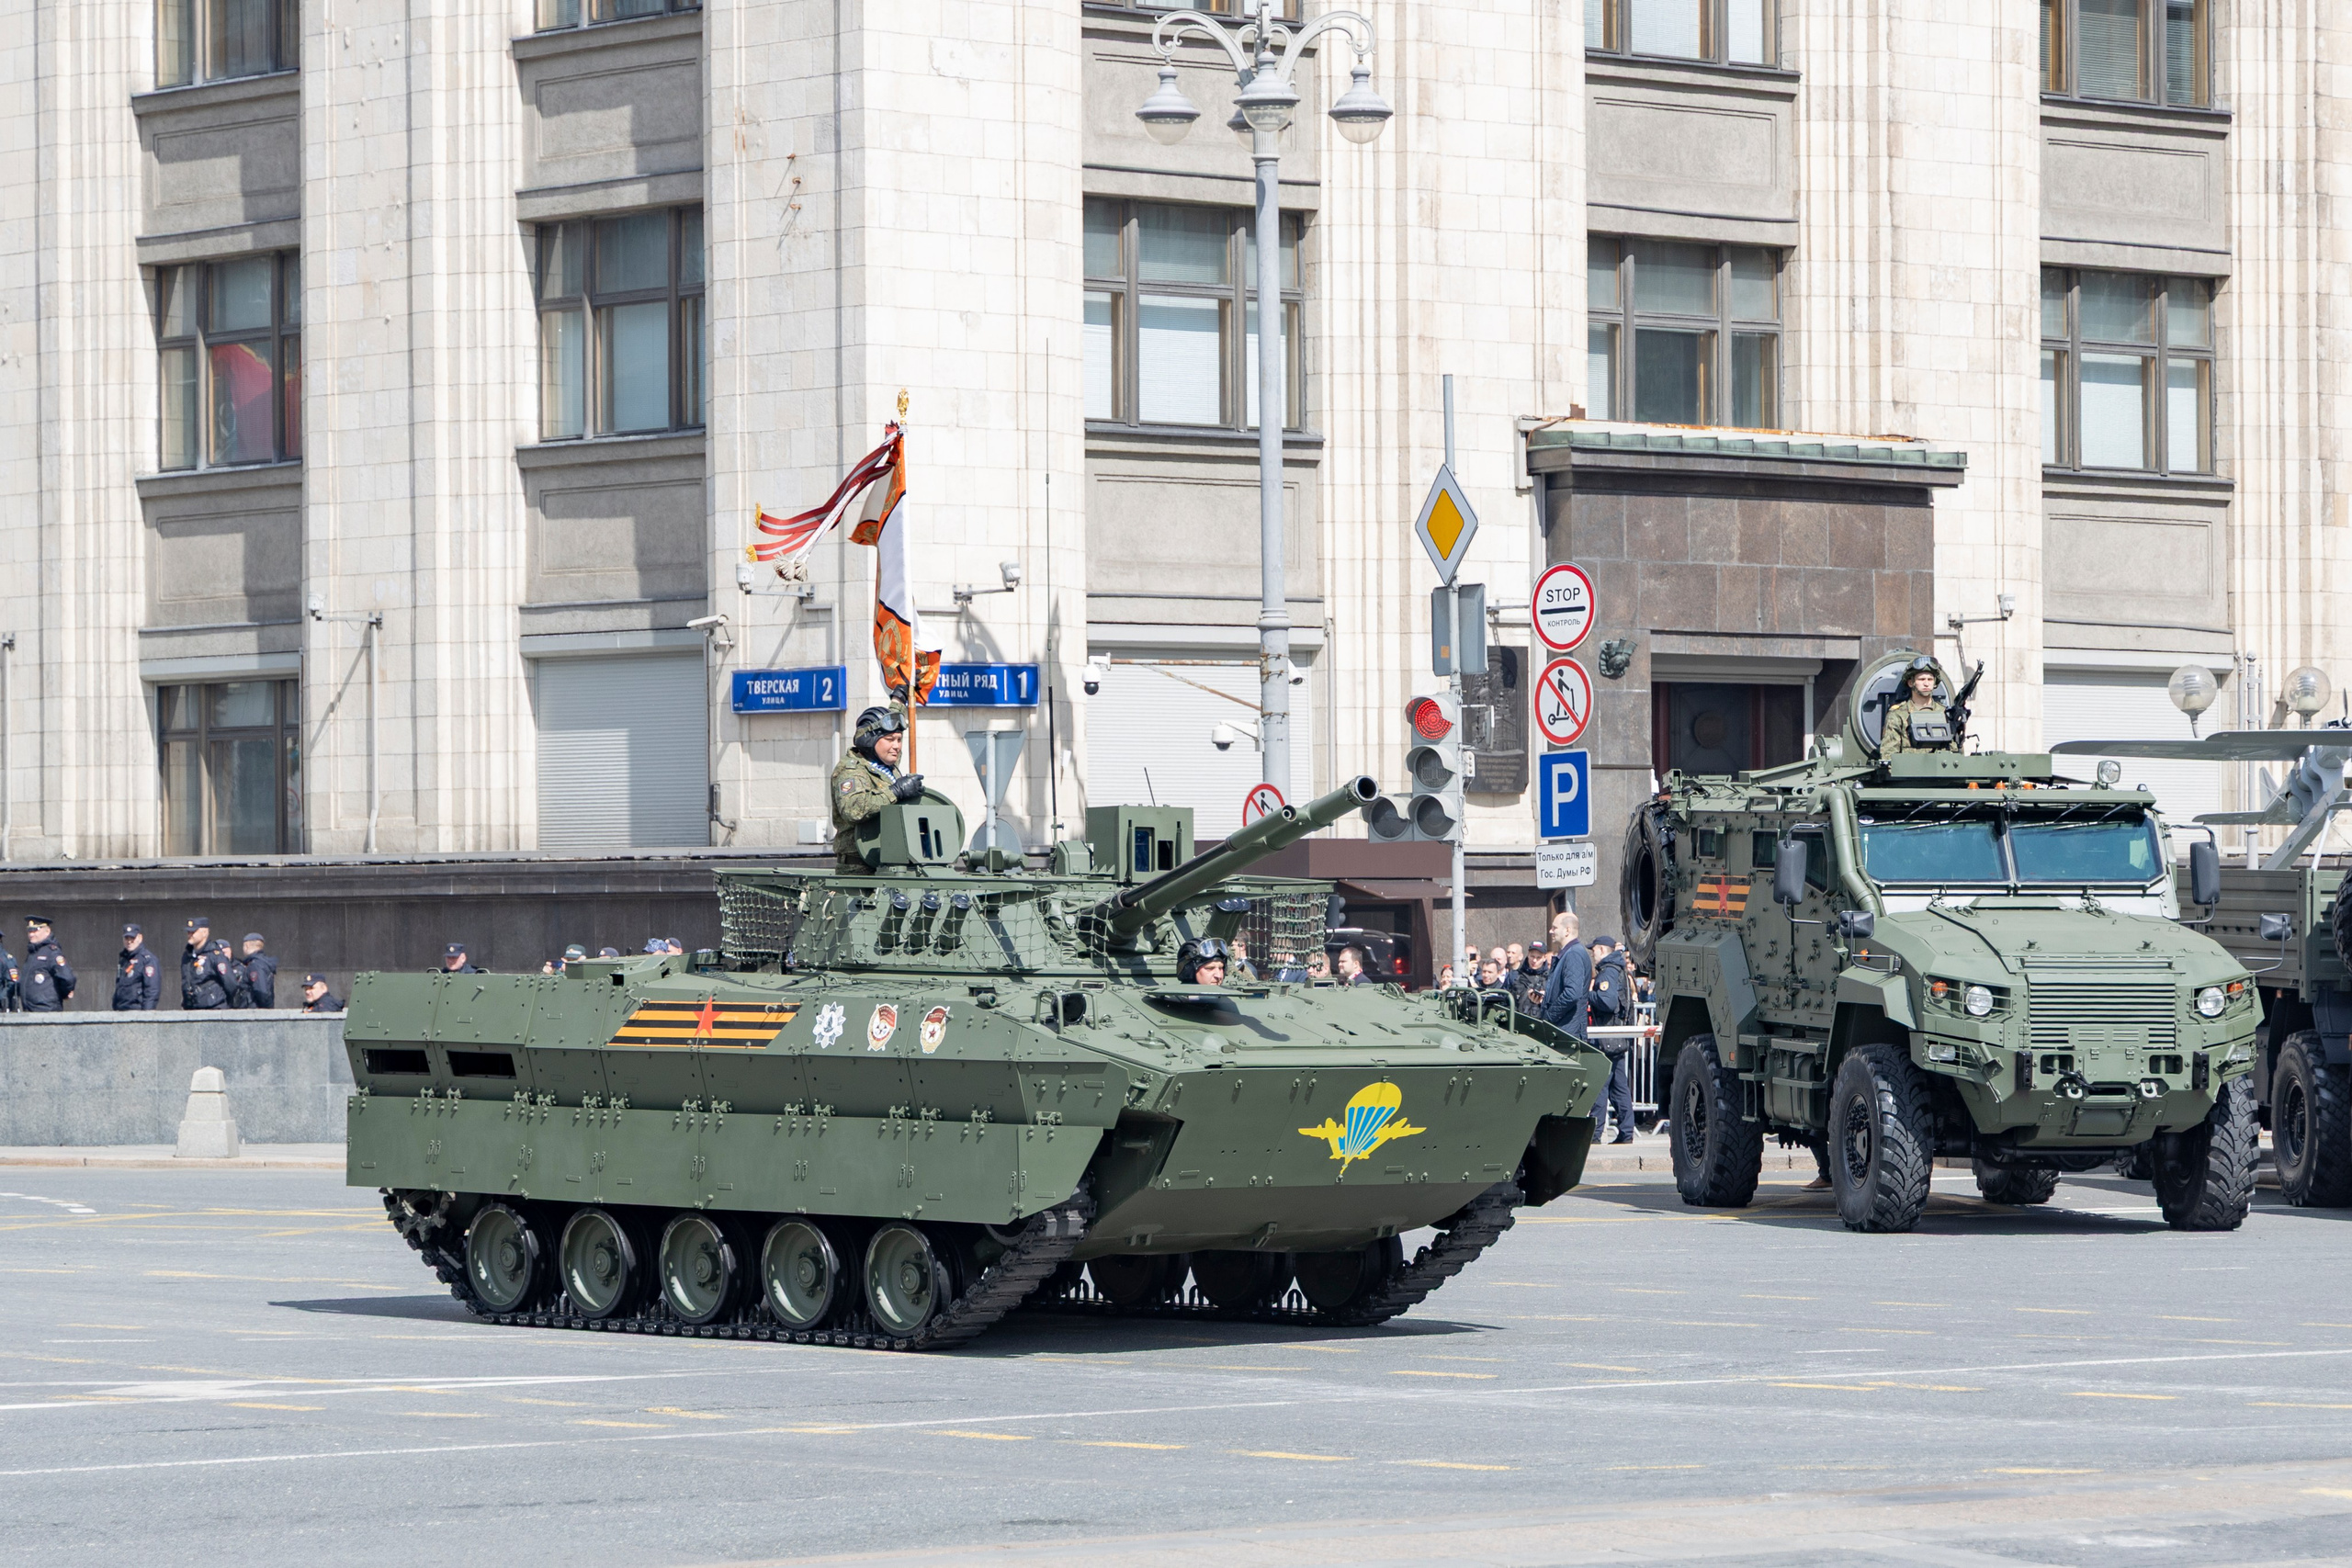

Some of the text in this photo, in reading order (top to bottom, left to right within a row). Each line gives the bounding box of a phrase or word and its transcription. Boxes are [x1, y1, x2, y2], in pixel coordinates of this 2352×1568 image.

[1546, 588, 1580, 603] STOP
[1547, 618, 1581, 627] КОНТРОЛЬ
[746, 679, 799, 694] ТВЕРСКАЯ
[821, 677, 832, 702] 2
[974, 674, 998, 690] РЯД
[1017, 671, 1028, 699] 1
[762, 696, 786, 705] УЛИЦА
[938, 690, 969, 698] УЛИЦА
[1552, 762, 1579, 828] P
[1537, 849, 1594, 862] Только для а/м
[1540, 866, 1591, 880] Гос. Думы РФ
